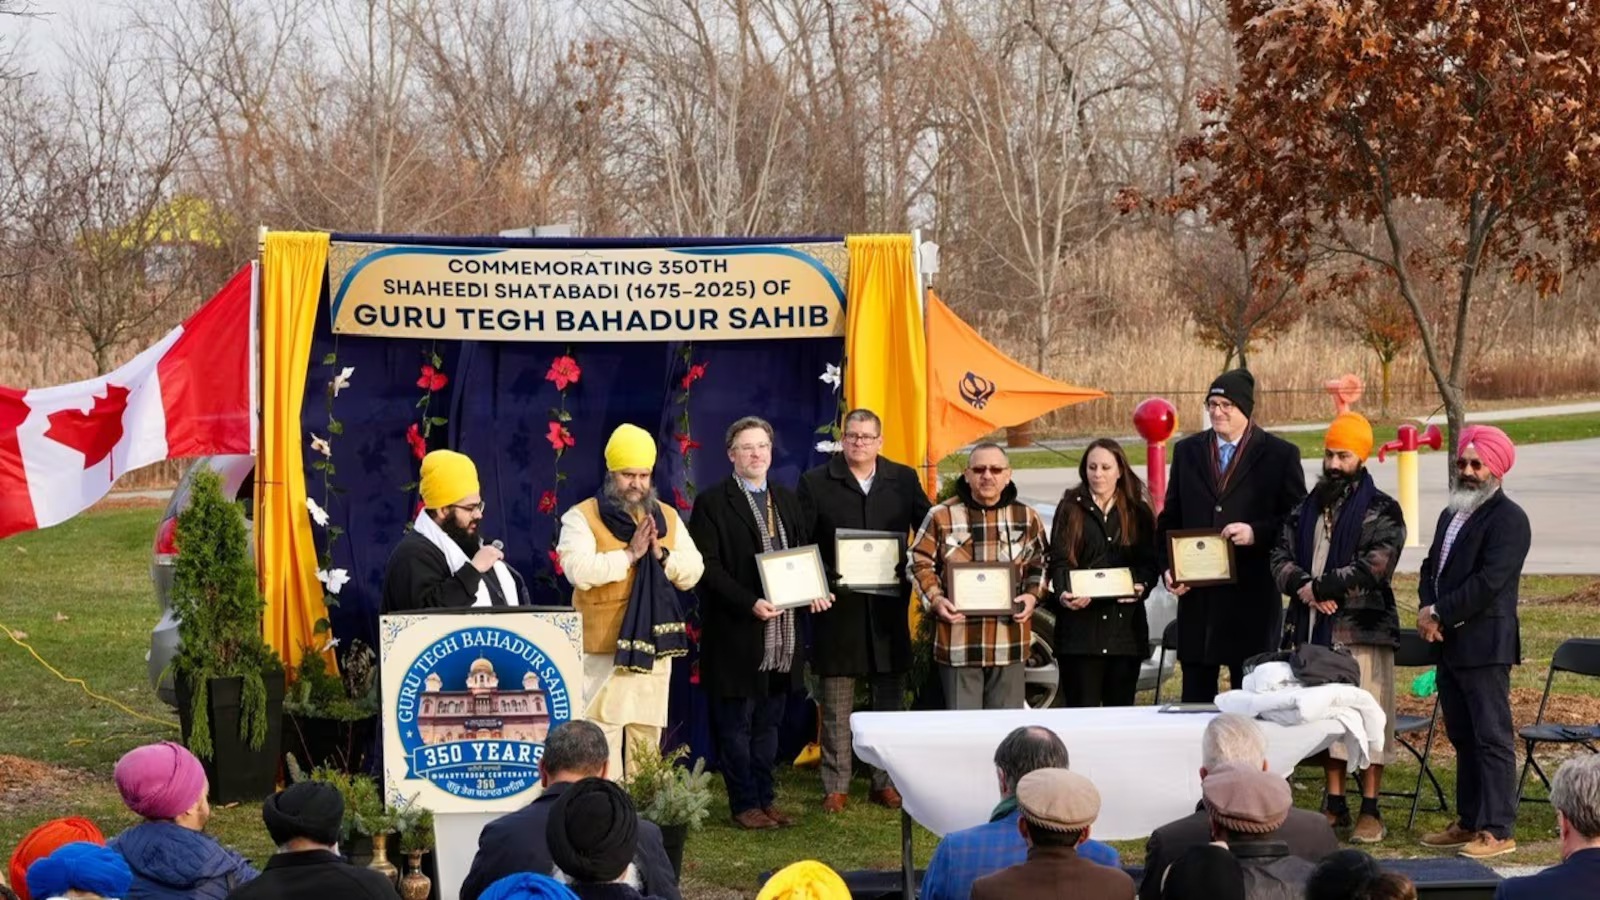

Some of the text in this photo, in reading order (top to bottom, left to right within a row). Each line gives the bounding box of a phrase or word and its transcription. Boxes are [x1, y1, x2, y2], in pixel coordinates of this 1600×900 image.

[448, 259, 728, 276] COMMEMORATING 350TH
[383, 279, 488, 298] SHAHEEDI
[495, 283, 618, 299] SHATABADI
[763, 280, 791, 295] OF
[354, 304, 829, 331] GURU TEGH BAHADUR SAHIB
[398, 630, 569, 723] GURU TEGH BAHADUR SAHIB
[424, 743, 545, 767] 350 YEARS
